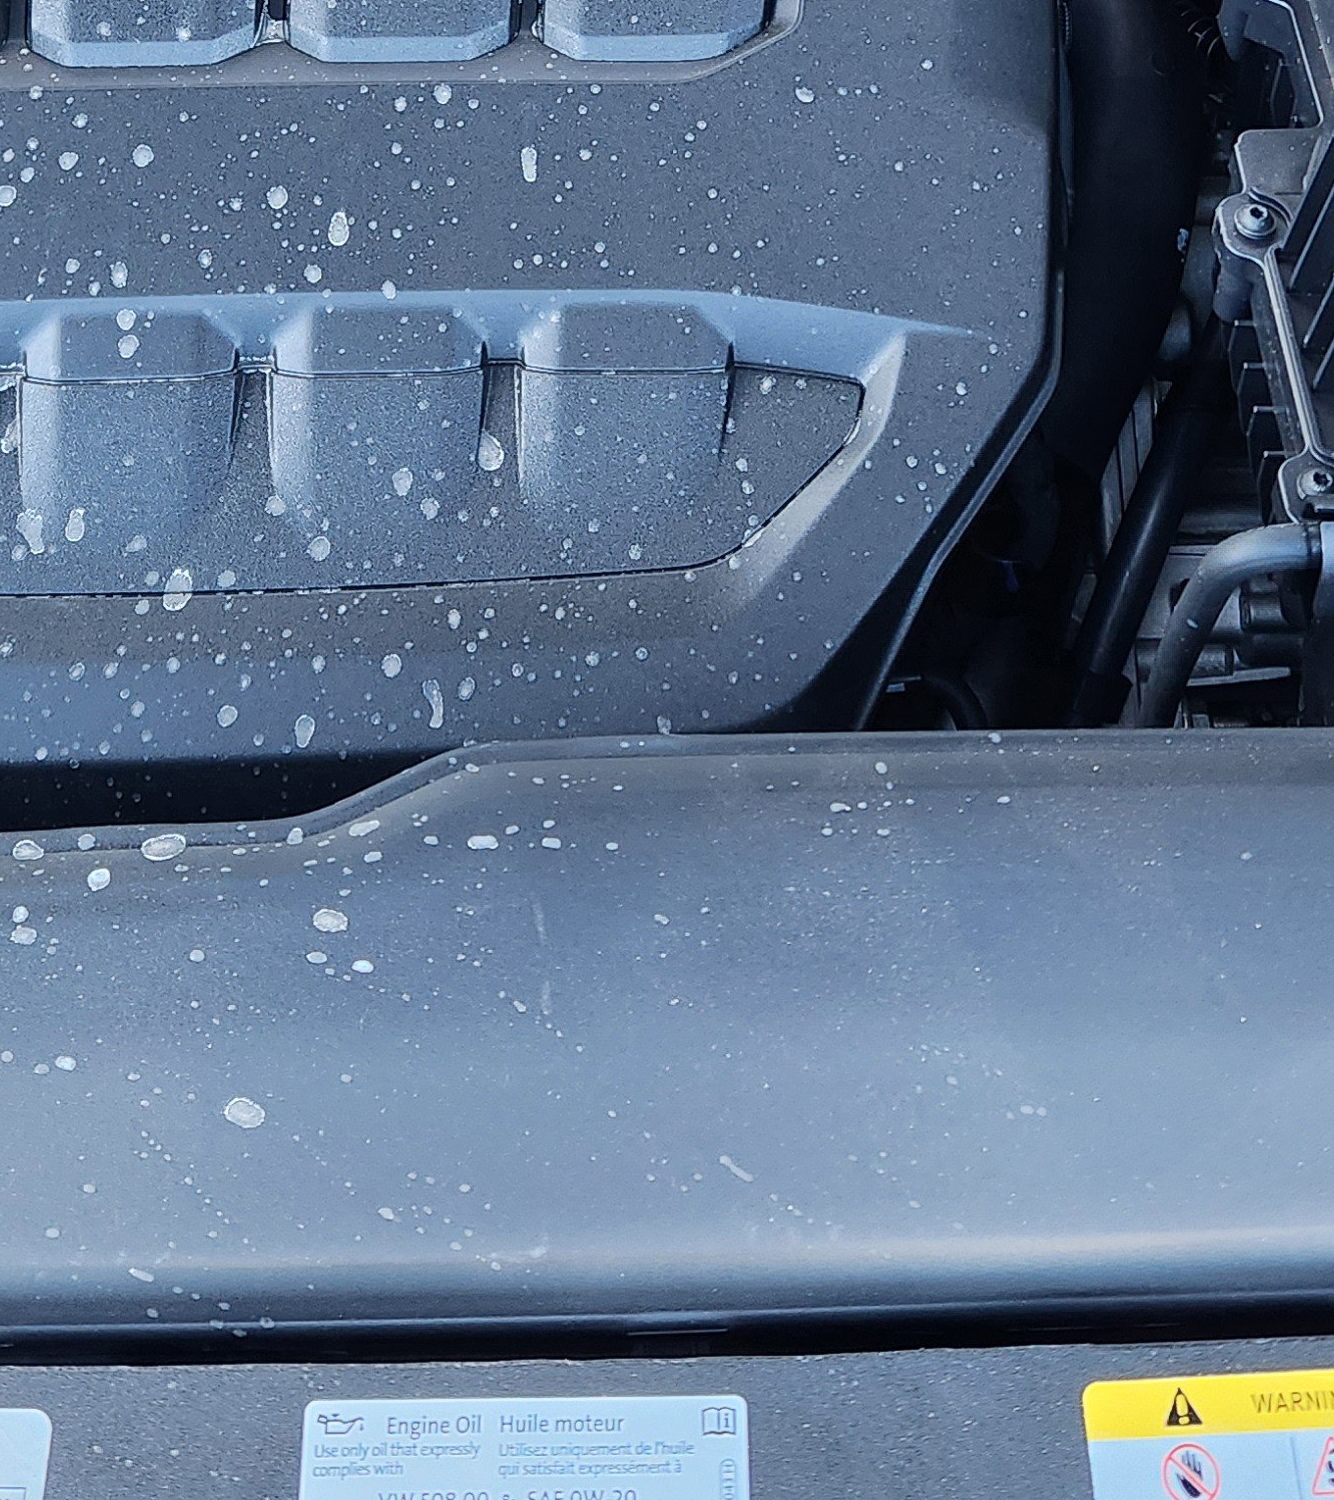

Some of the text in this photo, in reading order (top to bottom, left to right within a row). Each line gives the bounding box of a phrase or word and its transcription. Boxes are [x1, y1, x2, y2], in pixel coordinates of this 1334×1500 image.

[387, 1414, 482, 1440] Engine Oil
[500, 1414, 625, 1433] Huile moteur
[314, 1441, 482, 1460] Use only oil that expressly
[499, 1442, 548, 1457] Utilisez
[551, 1442, 631, 1460] uniquement
[635, 1441, 652, 1456] de
[312, 1461, 404, 1480] complies with
[498, 1461, 521, 1479] qui
[522, 1461, 575, 1476] satisfait
